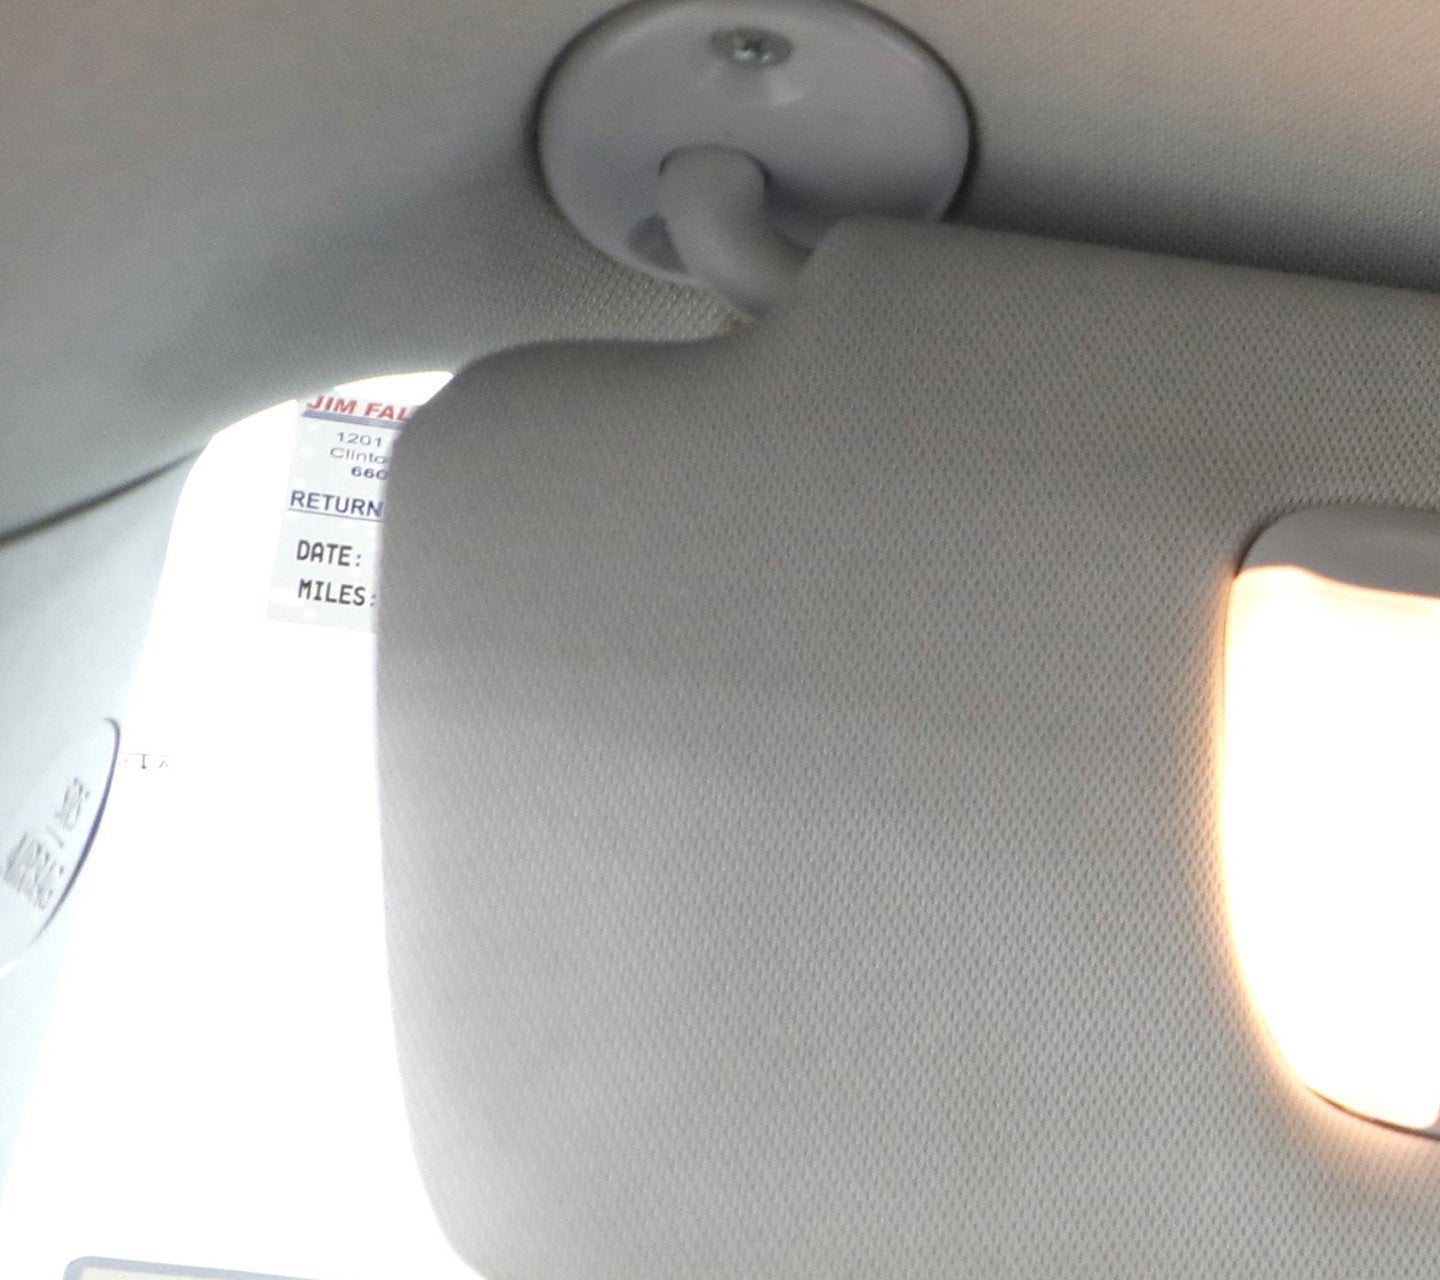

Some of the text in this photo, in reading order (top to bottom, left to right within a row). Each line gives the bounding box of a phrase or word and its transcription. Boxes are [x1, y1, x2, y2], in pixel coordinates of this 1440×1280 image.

[306, 395, 356, 415] JIM
[336, 431, 383, 448] 1201
[290, 490, 384, 518] RETURN
[296, 539, 362, 568] DATE:
[297, 578, 378, 607] MILES:
